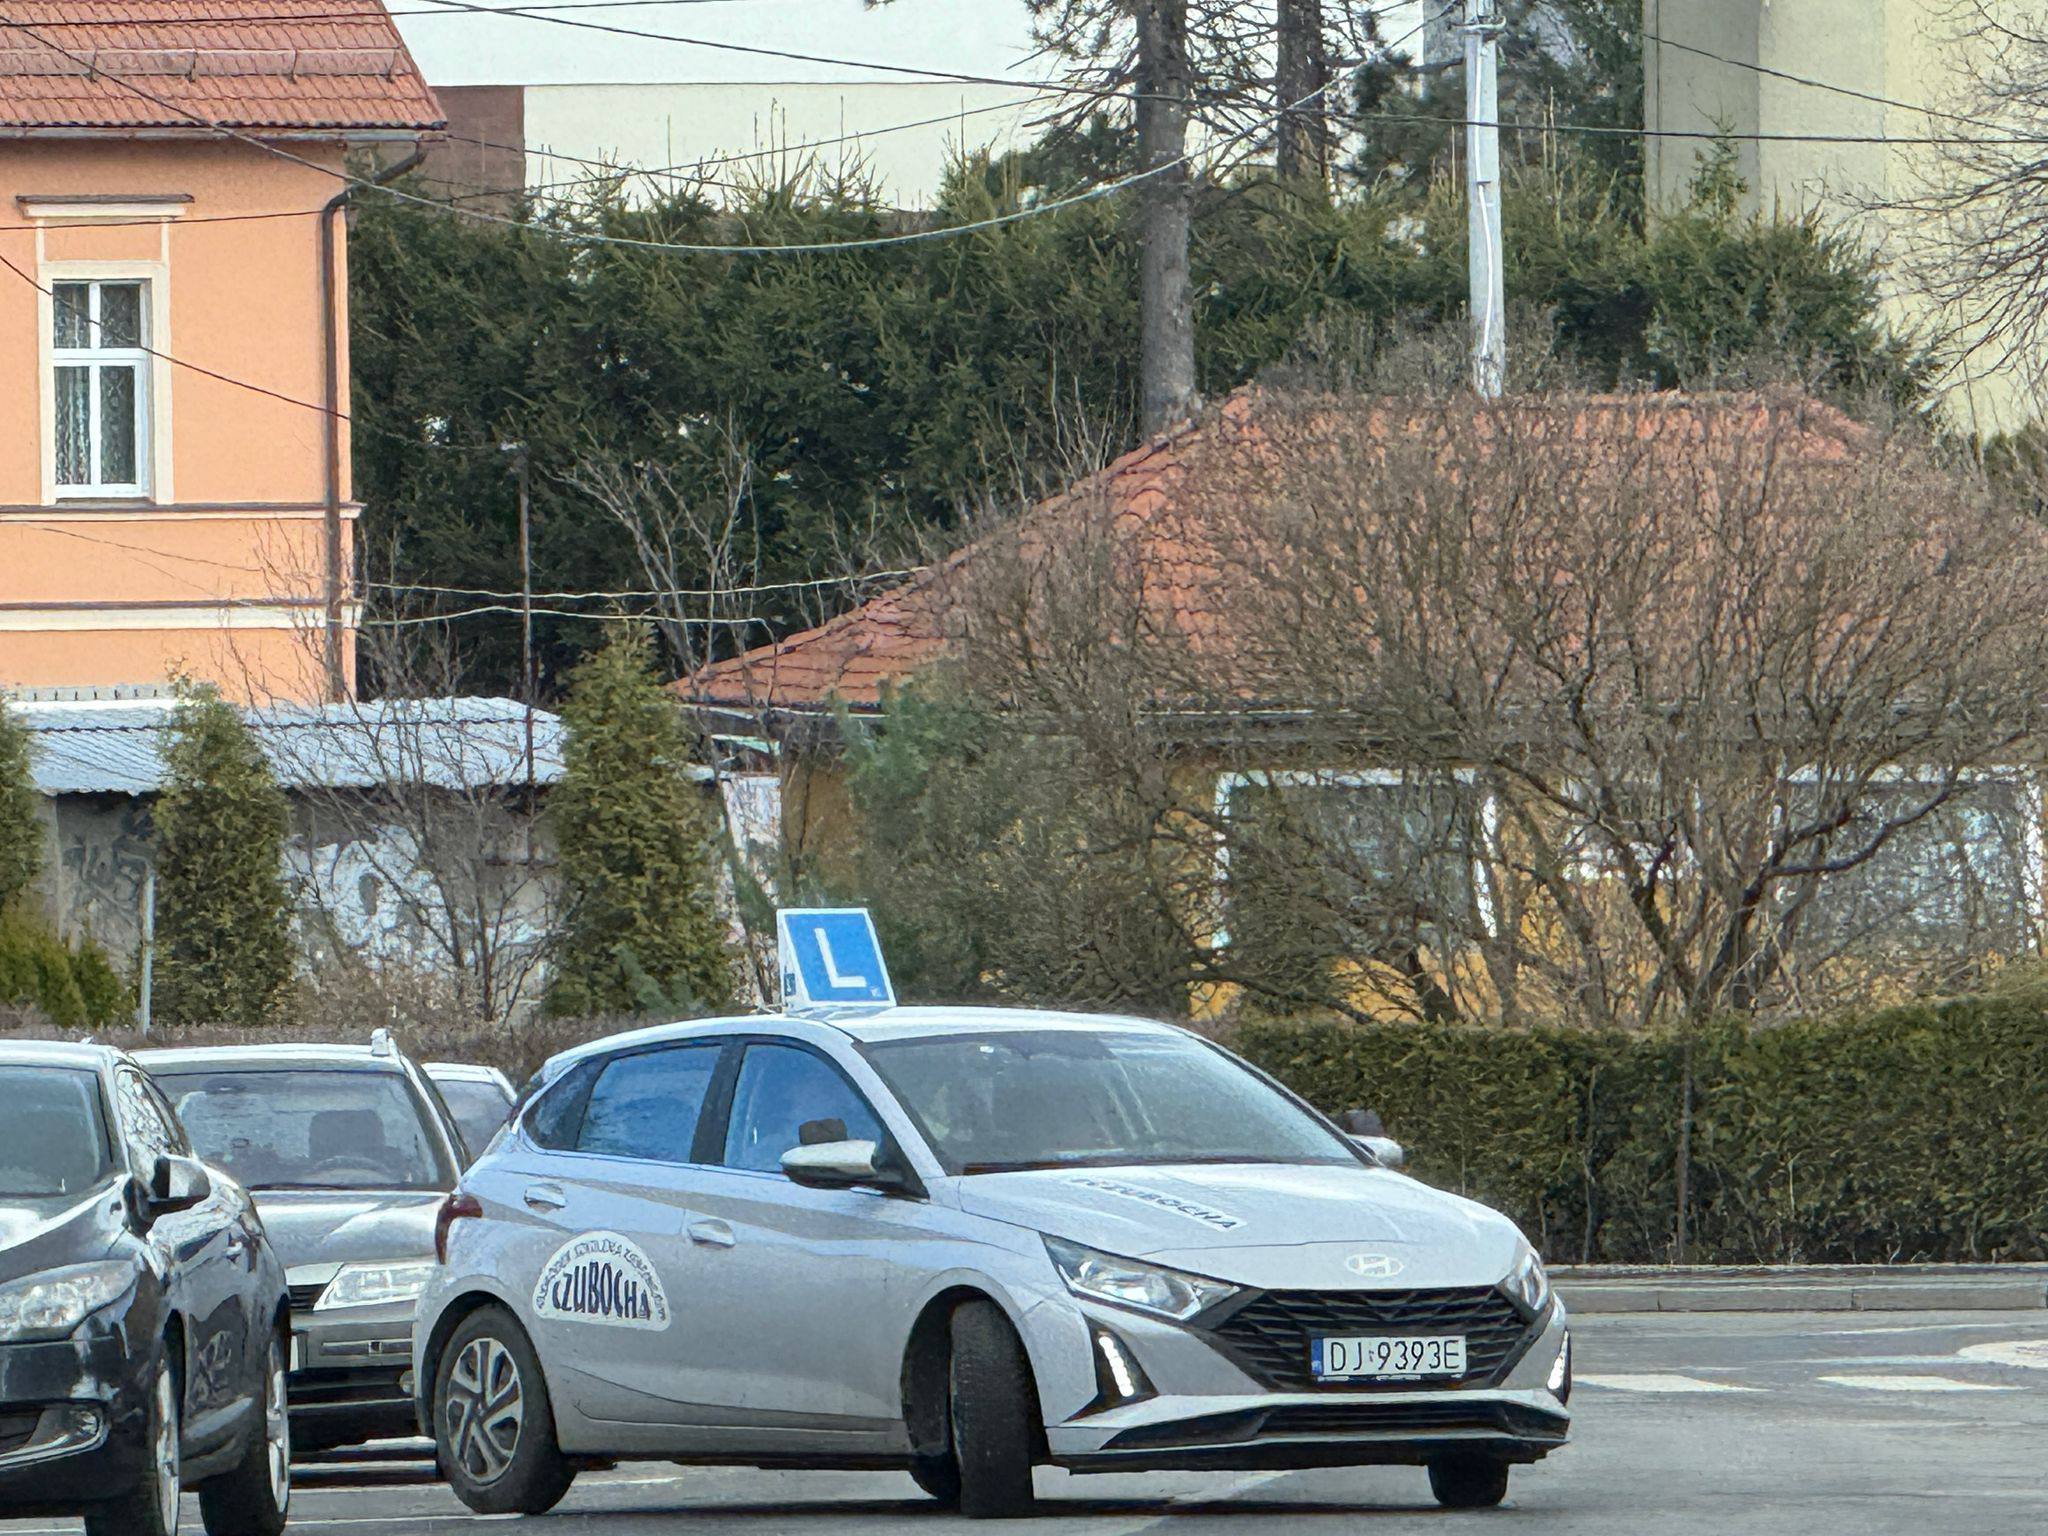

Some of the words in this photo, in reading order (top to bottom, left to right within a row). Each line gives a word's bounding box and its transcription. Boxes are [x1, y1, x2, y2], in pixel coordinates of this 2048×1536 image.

[814, 927, 868, 988] L
[1070, 1178, 1237, 1228] BOCHA
[552, 1261, 651, 1321] CZUBOCHA
[1330, 1341, 1362, 1371] DJ
[1377, 1340, 1460, 1371] 9393E
